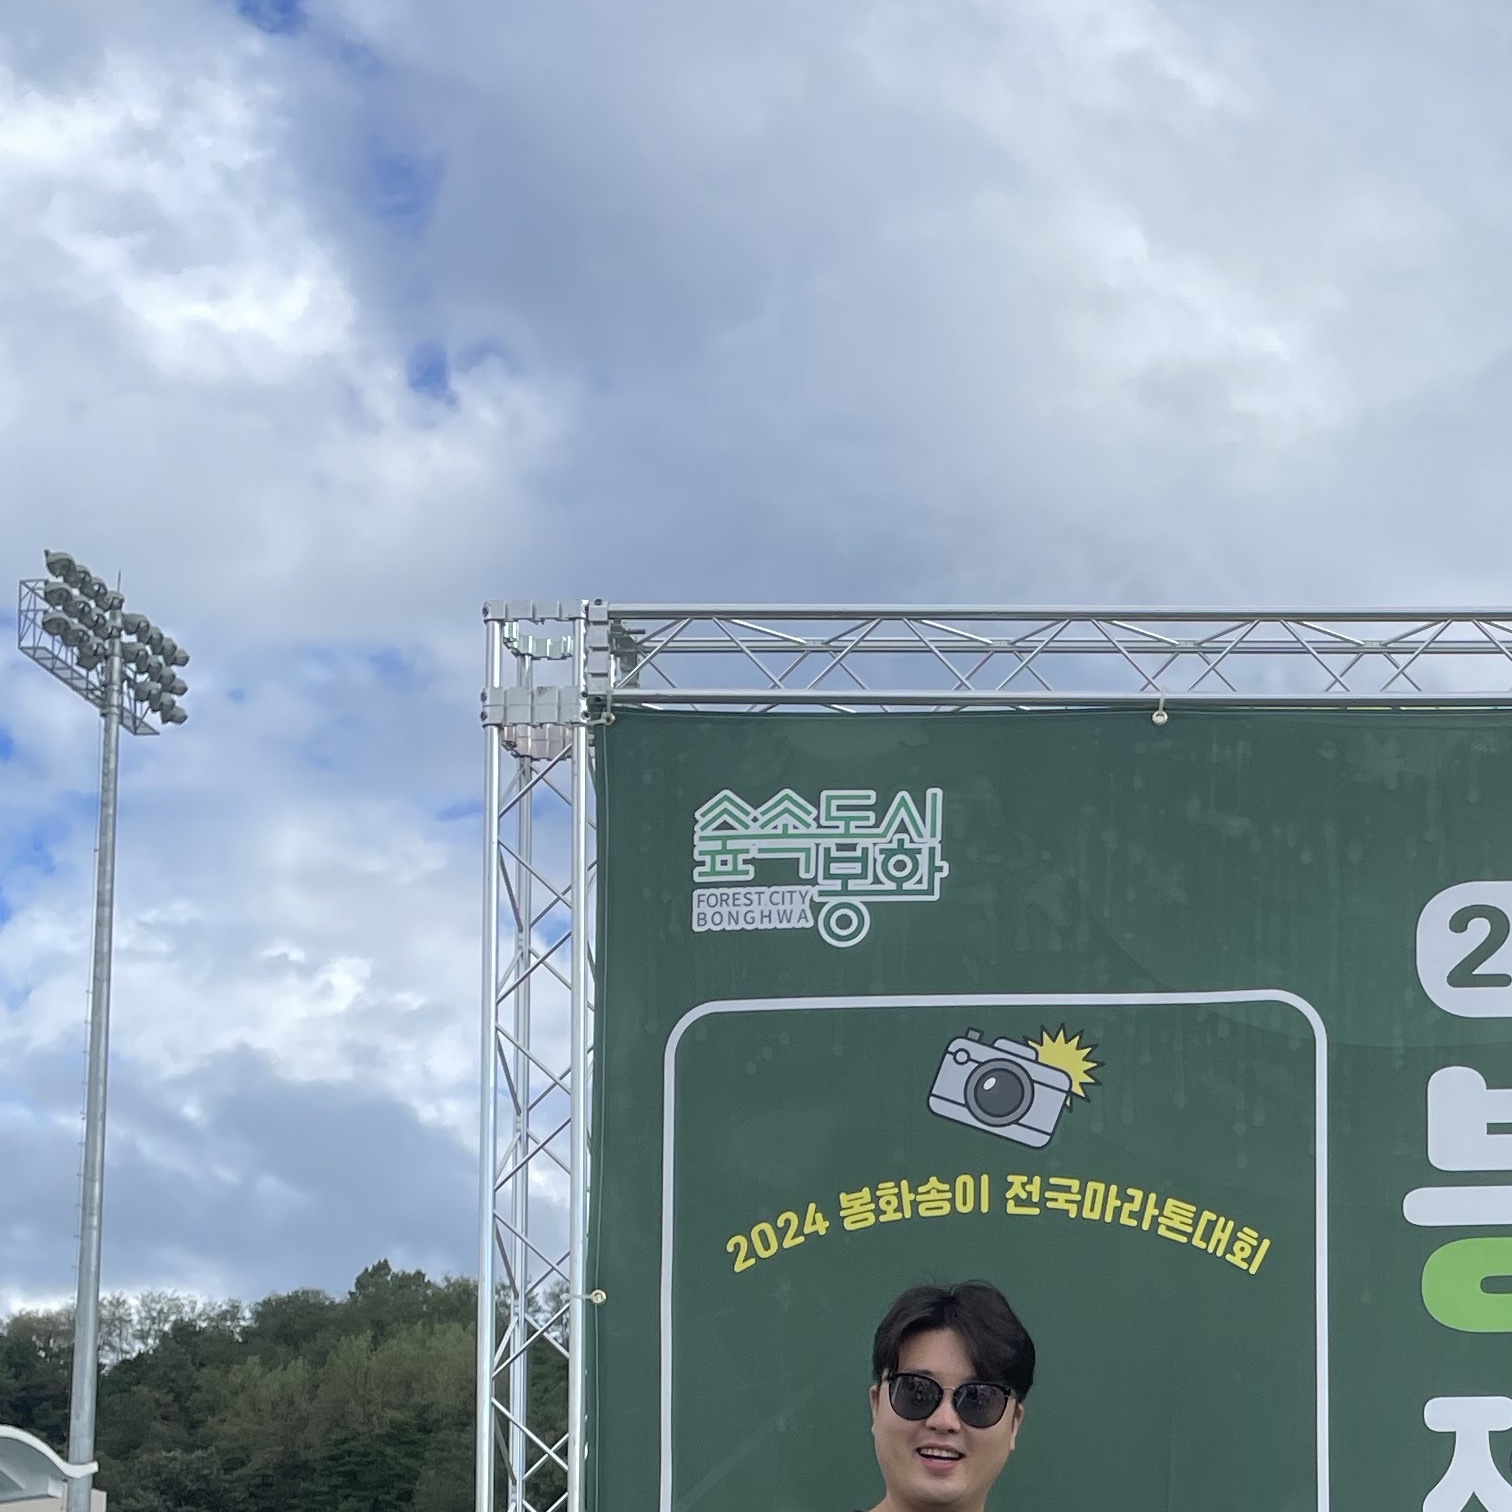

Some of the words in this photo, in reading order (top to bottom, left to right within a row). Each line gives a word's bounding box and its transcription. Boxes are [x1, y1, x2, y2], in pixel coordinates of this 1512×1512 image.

[697, 890, 765, 909] FOREST
[770, 889, 809, 905] CITY
[697, 909, 809, 927] BONGHWA
[727, 1203, 829, 1272] 2024
[840, 1174, 989, 1230] 봉화송이
[1006, 1175, 1270, 1274] 전국마라톤대회
